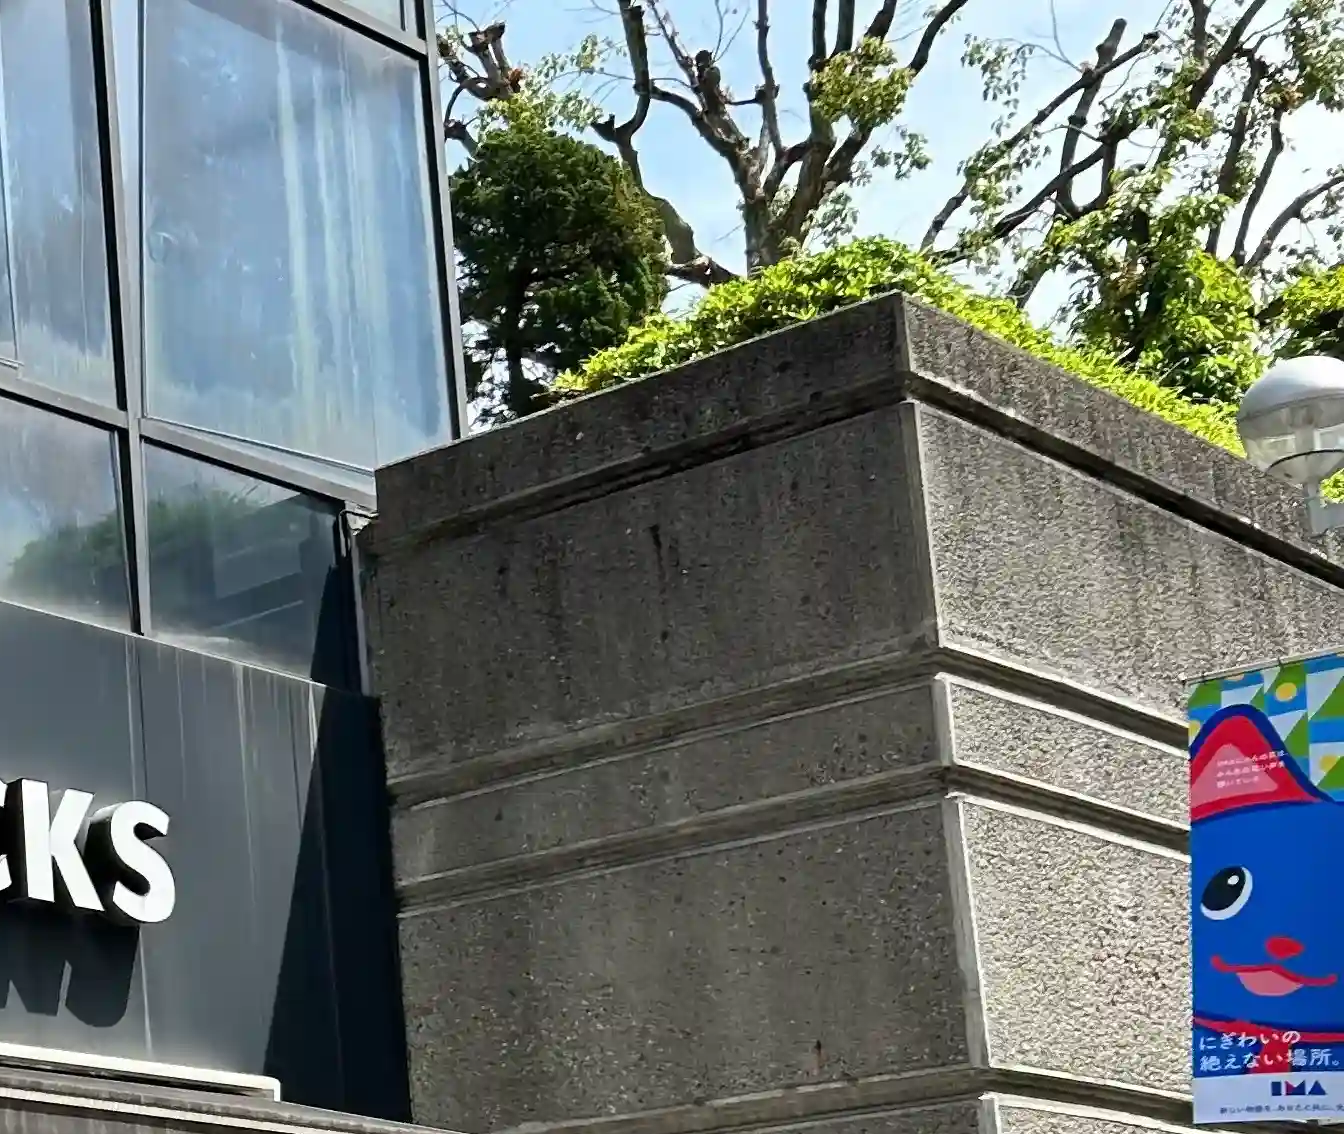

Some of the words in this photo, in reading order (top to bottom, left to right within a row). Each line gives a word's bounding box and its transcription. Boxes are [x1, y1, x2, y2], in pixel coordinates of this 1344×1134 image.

[1199, 1030, 1301, 1050] にぎわいの
[1199, 1048, 1340, 1071] 絶えない場所。
[1271, 1080, 1327, 1096] IMA
